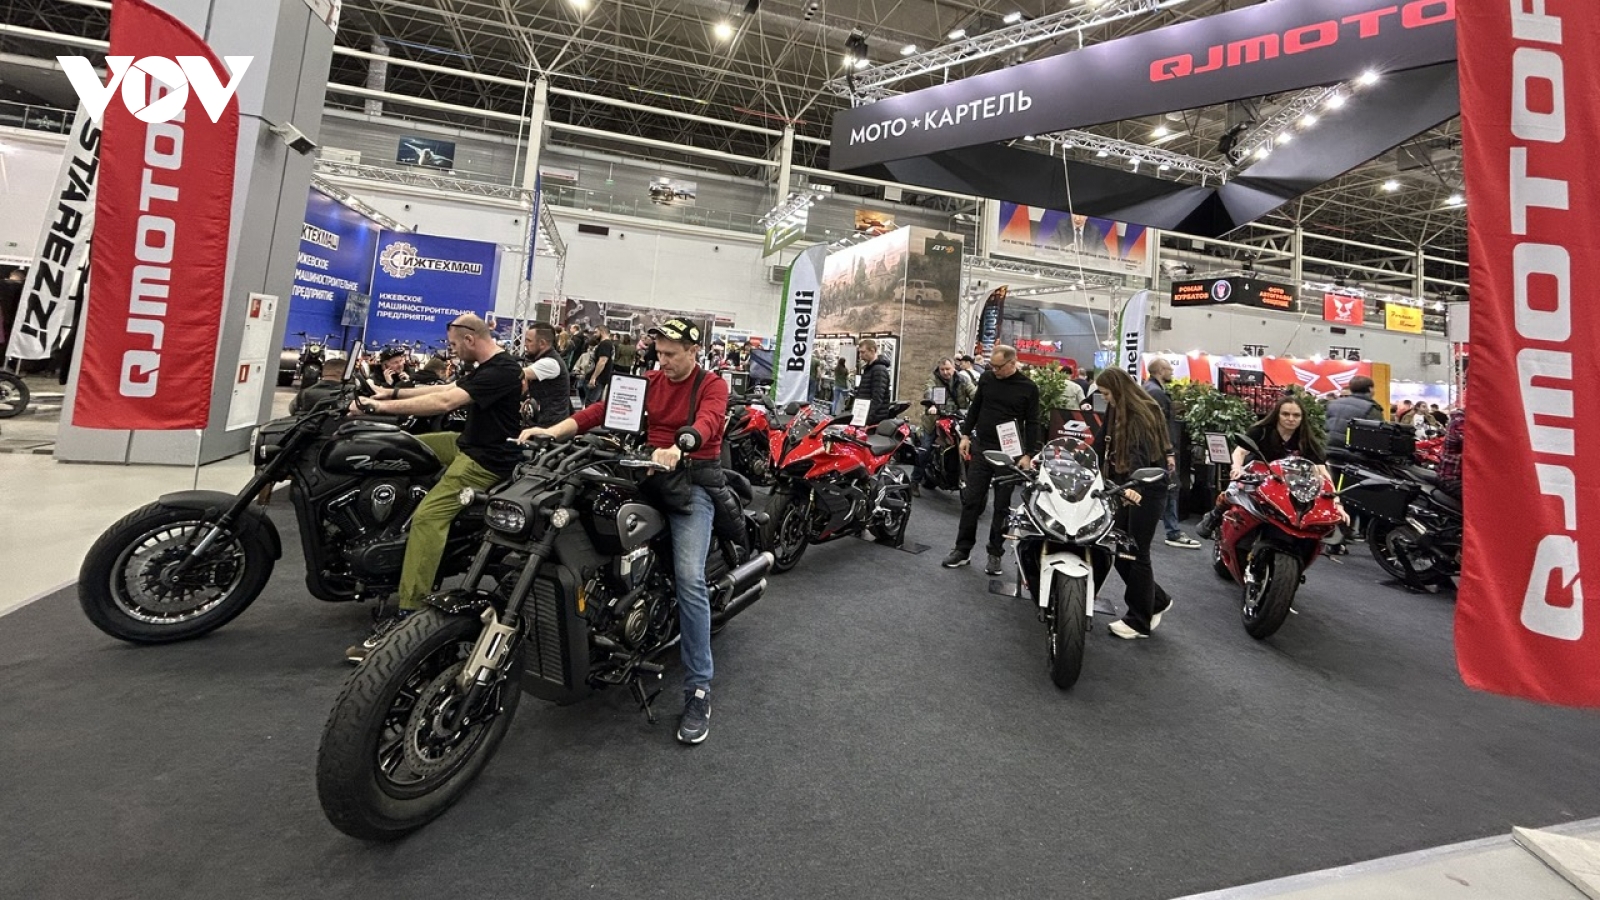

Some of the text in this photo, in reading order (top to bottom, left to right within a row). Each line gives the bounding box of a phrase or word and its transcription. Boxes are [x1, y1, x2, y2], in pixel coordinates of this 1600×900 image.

[849, 90, 1032, 146] МОТО КАРТЕЛЬ
[402, 256, 482, 273] ИЖТЕХМАШ
[379, 292, 423, 303] ИЖЕВСКОЕ
[376, 310, 436, 322] ПРЕДПРИЯТИЕ
[786, 290, 815, 372] Benelli
